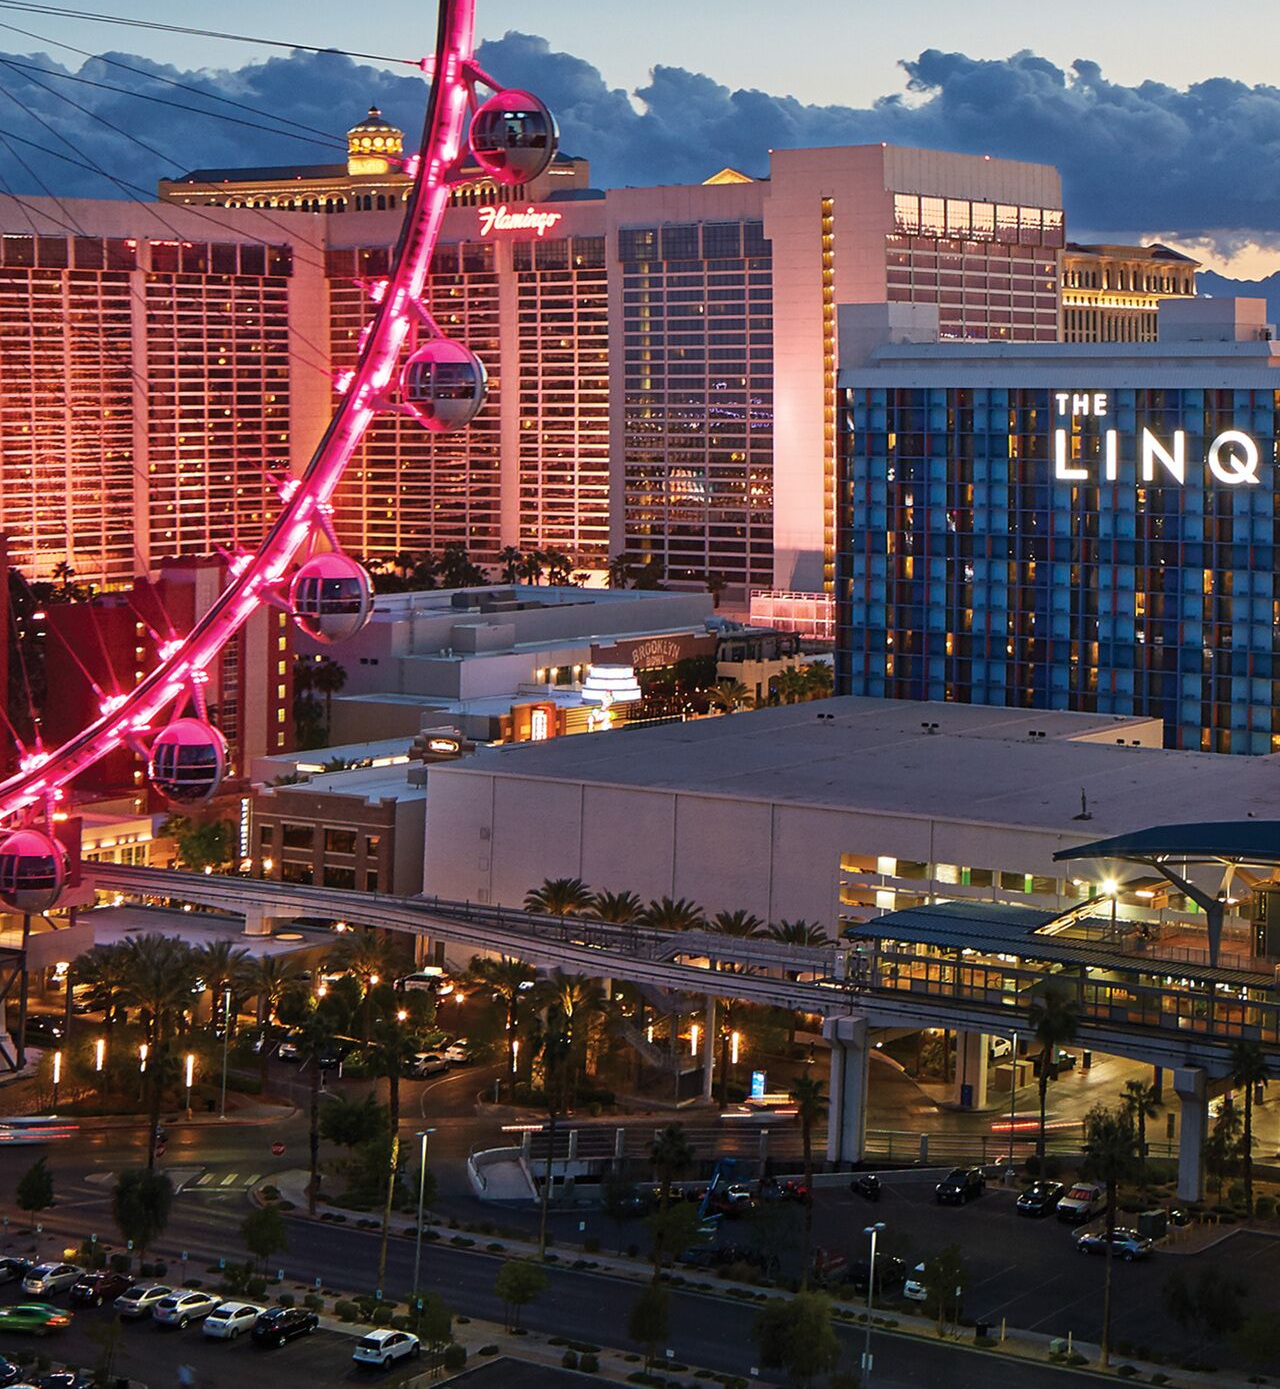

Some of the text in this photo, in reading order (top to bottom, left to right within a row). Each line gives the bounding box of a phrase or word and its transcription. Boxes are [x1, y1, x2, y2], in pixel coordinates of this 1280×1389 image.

[478, 205, 562, 236] Flamingo
[1055, 393, 1108, 416] THE
[1055, 426, 1261, 486] LINQ
[632, 639, 681, 664] BROOKLYN
